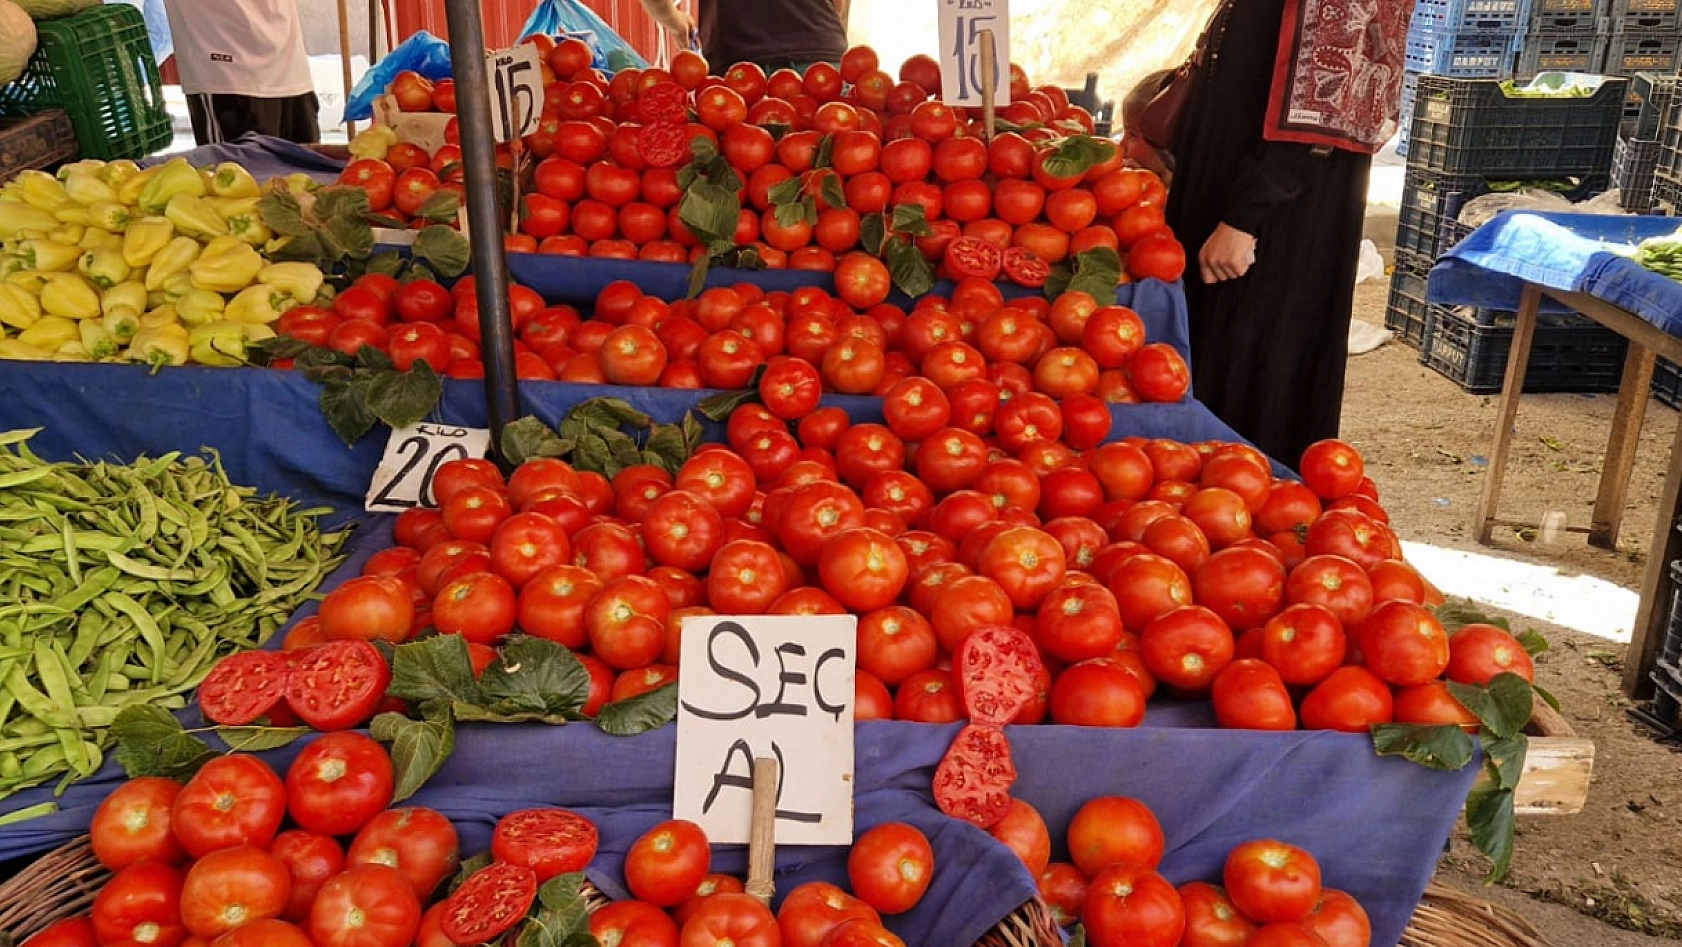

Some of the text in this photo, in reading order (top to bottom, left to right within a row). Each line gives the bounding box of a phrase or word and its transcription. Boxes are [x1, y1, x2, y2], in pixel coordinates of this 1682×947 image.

[953, 16, 1000, 99] 15
[495, 61, 533, 141] 15
[416, 424, 468, 437] KILO
[369, 435, 468, 509] 20
[702, 738, 823, 824] AL
